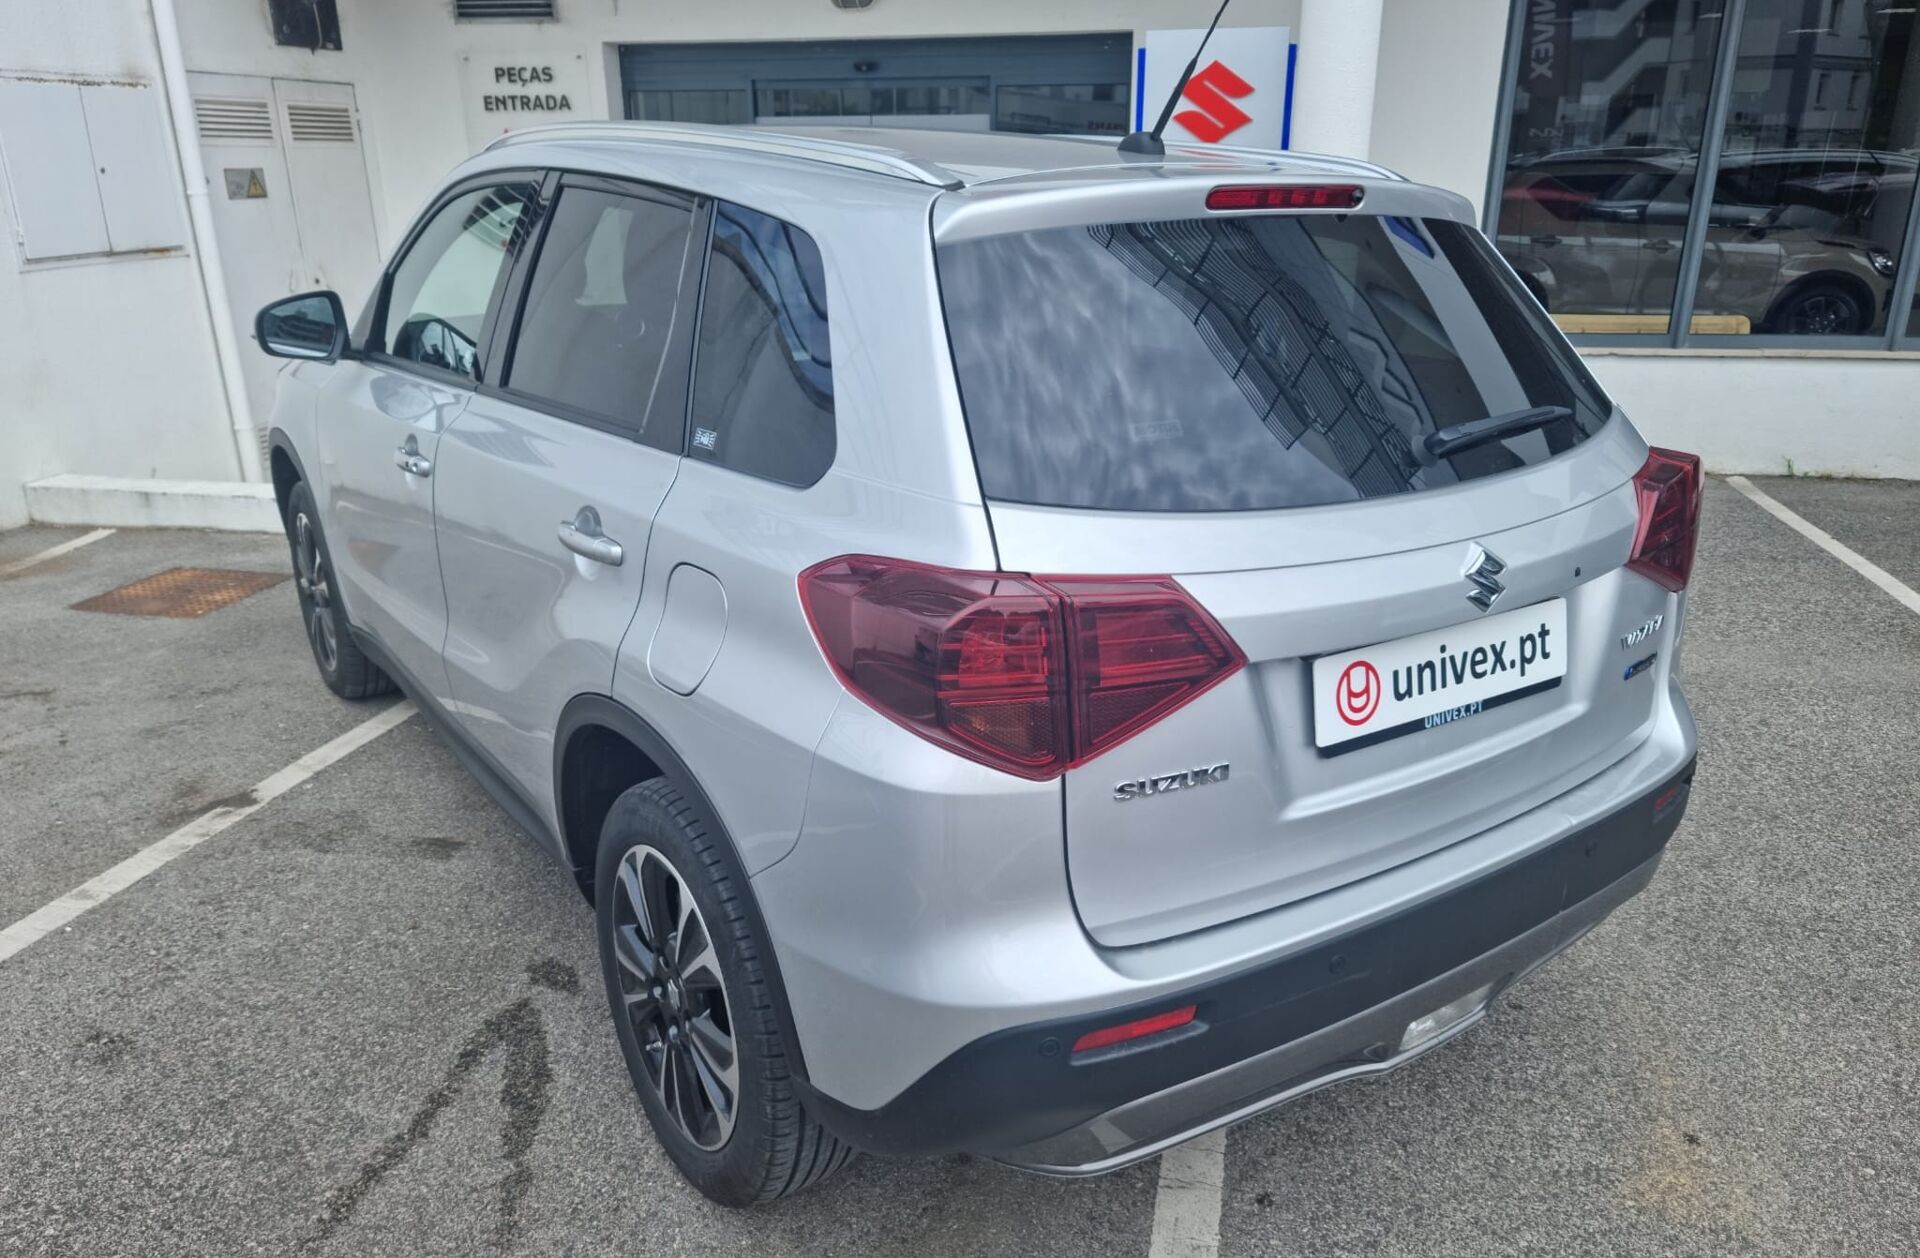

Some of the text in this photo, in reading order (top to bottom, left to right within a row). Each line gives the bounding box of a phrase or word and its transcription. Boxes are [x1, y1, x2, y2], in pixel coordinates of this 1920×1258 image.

[494, 66, 554, 88] PEÇAS
[483, 94, 572, 112] ENTRADA
[1392, 623, 1551, 702] univex.pt
[1424, 700, 1484, 730] UNIVEX.PT
[1113, 761, 1230, 801] SUZUKI
